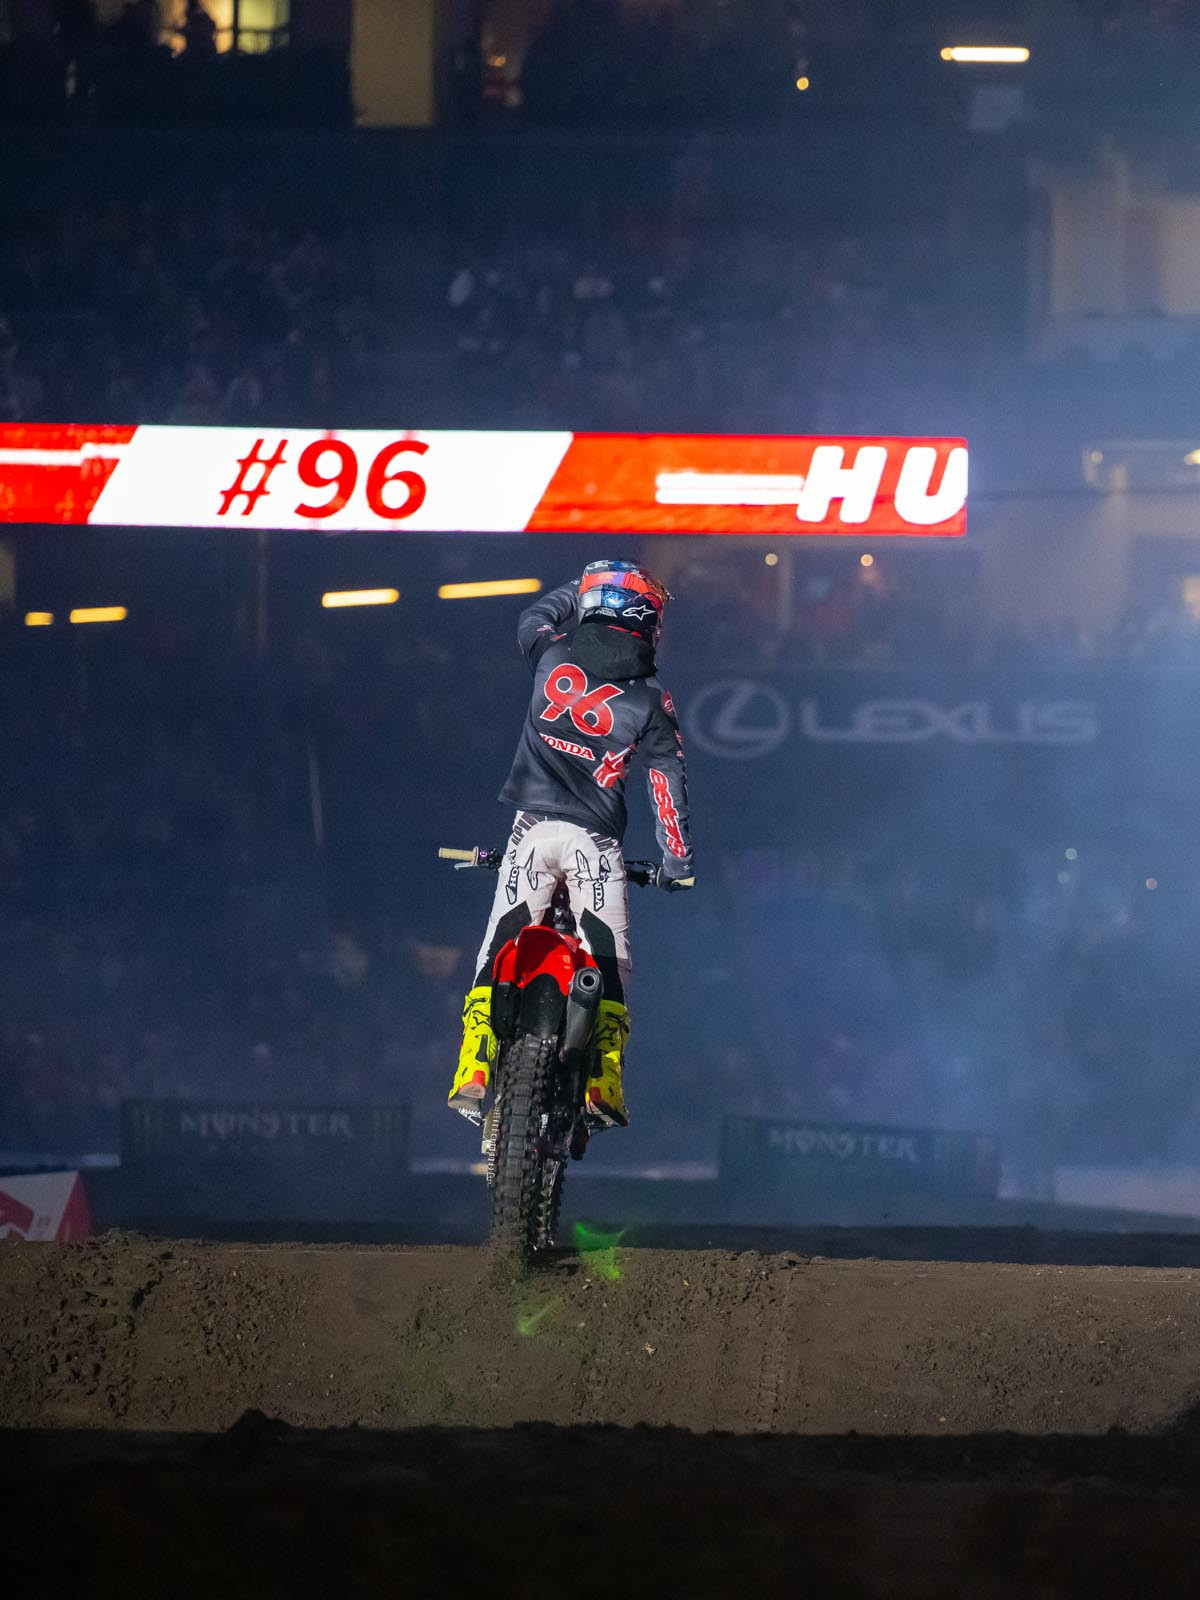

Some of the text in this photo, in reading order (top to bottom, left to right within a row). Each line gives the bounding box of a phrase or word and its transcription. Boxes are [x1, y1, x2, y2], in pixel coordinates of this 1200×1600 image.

[217, 438, 430, 520] #96
[540, 663, 624, 736] 96
[802, 698, 1098, 741] LEXUS
[178, 1110, 352, 1141] MONSTER
[767, 1125, 920, 1162] MONSTER
